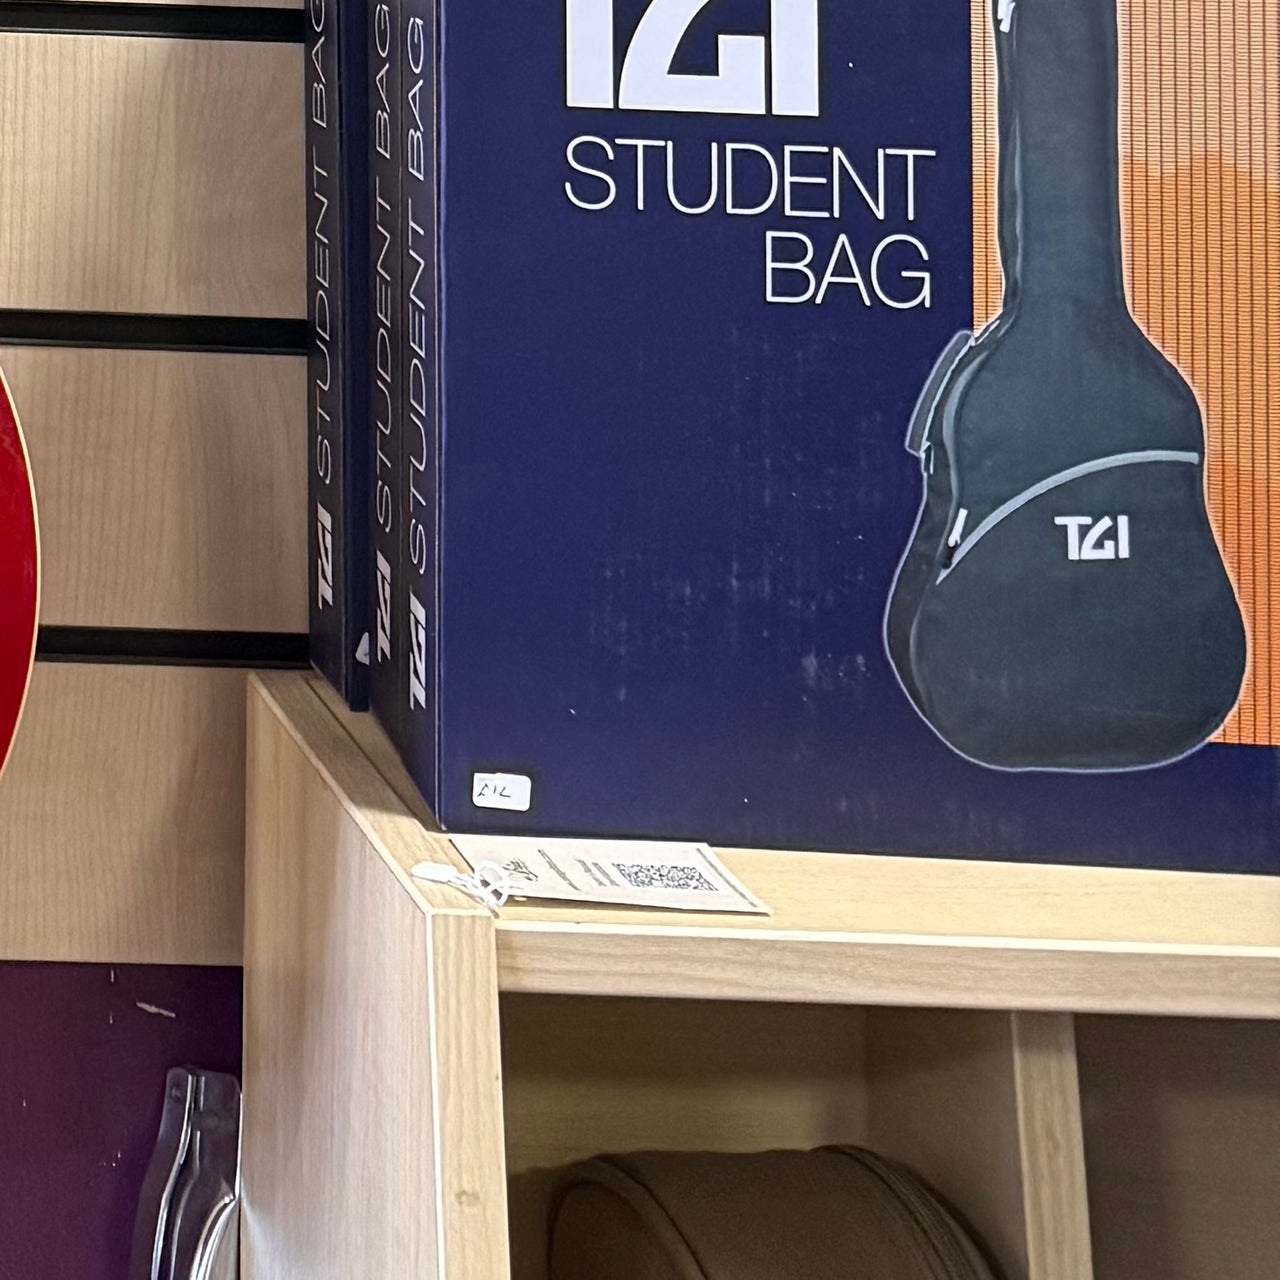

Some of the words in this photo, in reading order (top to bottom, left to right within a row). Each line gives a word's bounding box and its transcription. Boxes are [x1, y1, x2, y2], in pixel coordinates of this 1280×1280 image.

[374, 3, 391, 160] BAG
[407, 17, 425, 181] BAG
[565, 135, 937, 222] STUDENT
[312, 145, 332, 485] STUDENT
[765, 232, 932, 310] BAG
[375, 175, 393, 533] STUDENT
[408, 198, 427, 575] STUDENT
[1054, 514, 1130, 560] TGI
